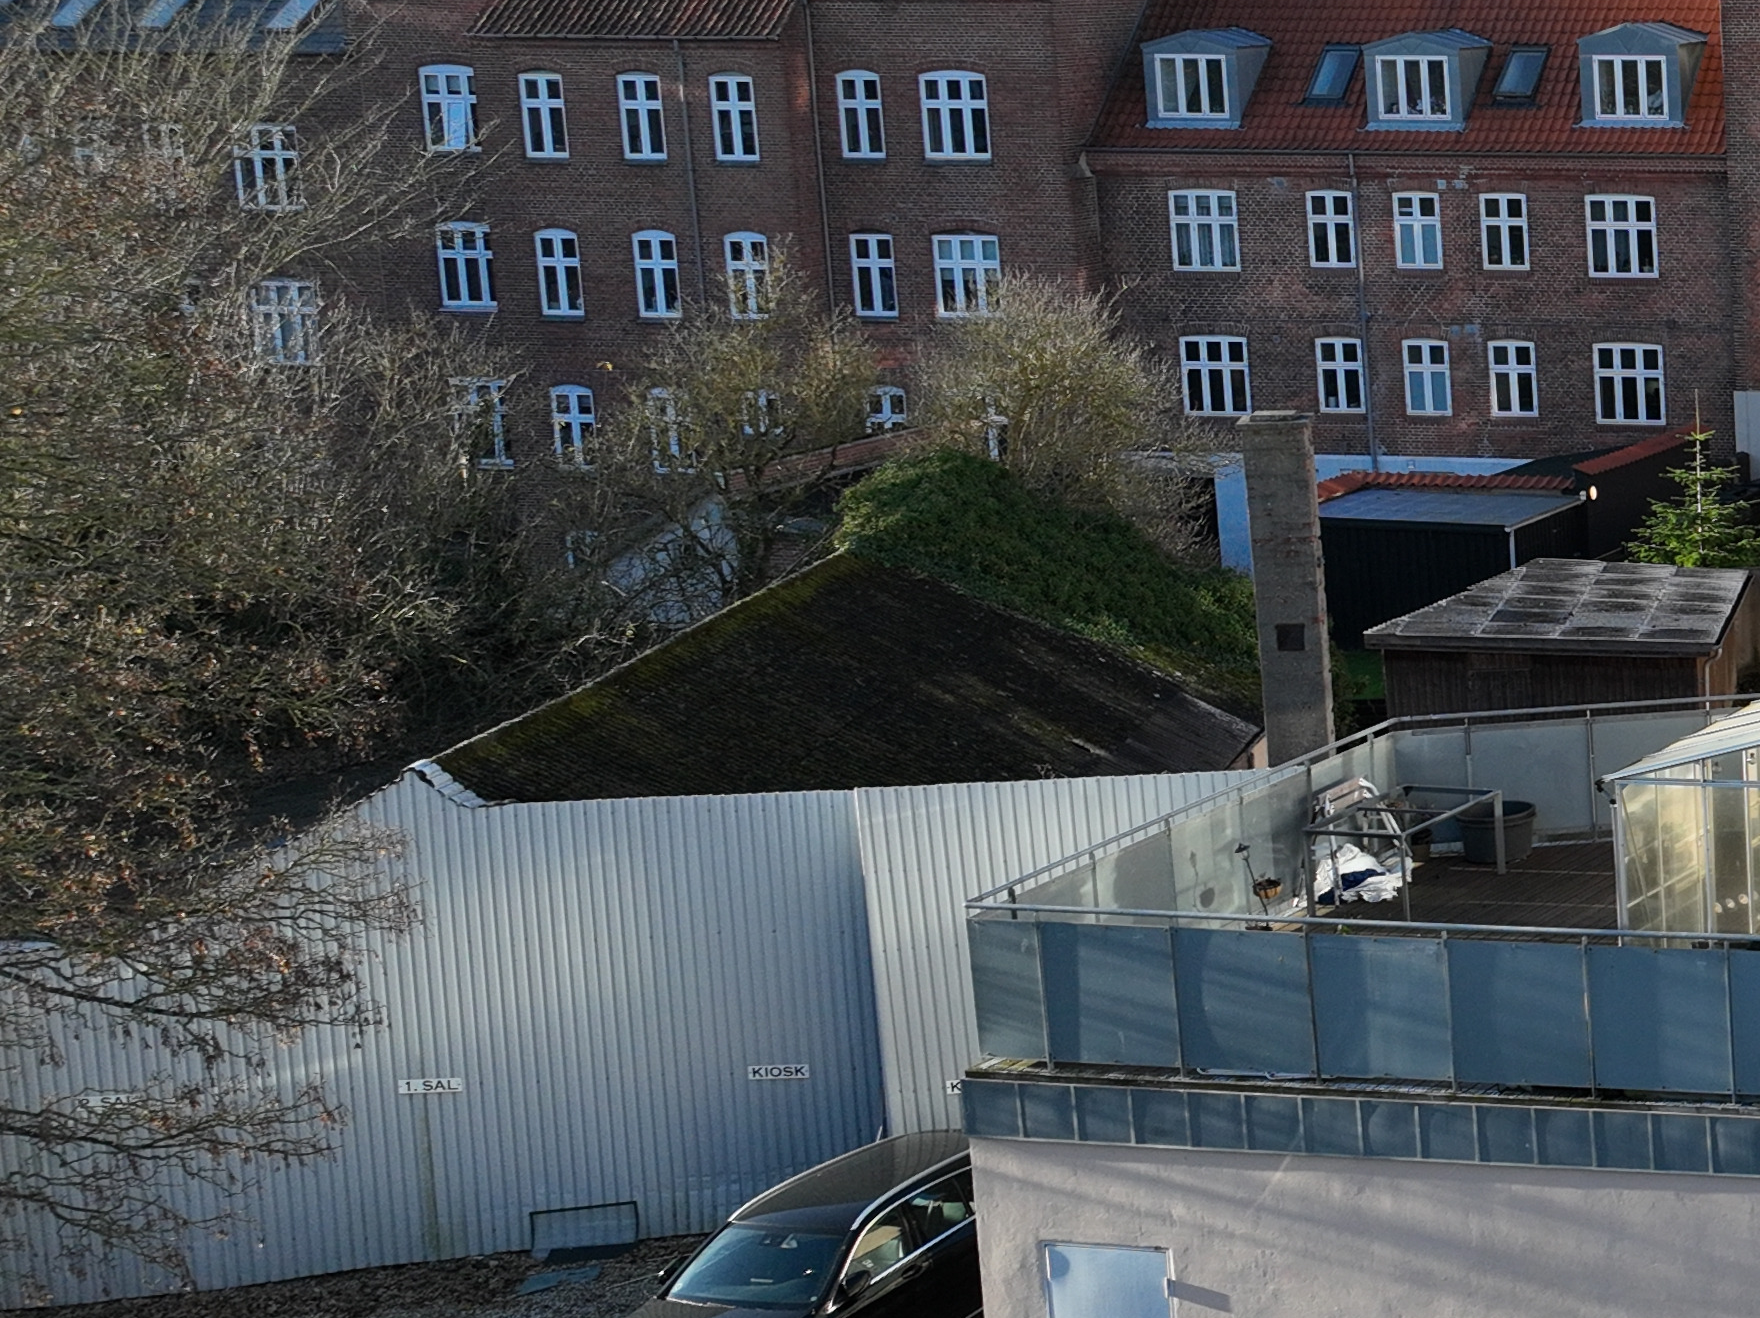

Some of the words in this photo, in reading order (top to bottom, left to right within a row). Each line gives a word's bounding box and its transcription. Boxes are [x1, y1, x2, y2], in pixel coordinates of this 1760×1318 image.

[752, 1066, 806, 1078] KIOSK
[405, 1081, 418, 1092] 1.
[422, 1079, 459, 1092] SAL
[950, 1081, 962, 1093] K
